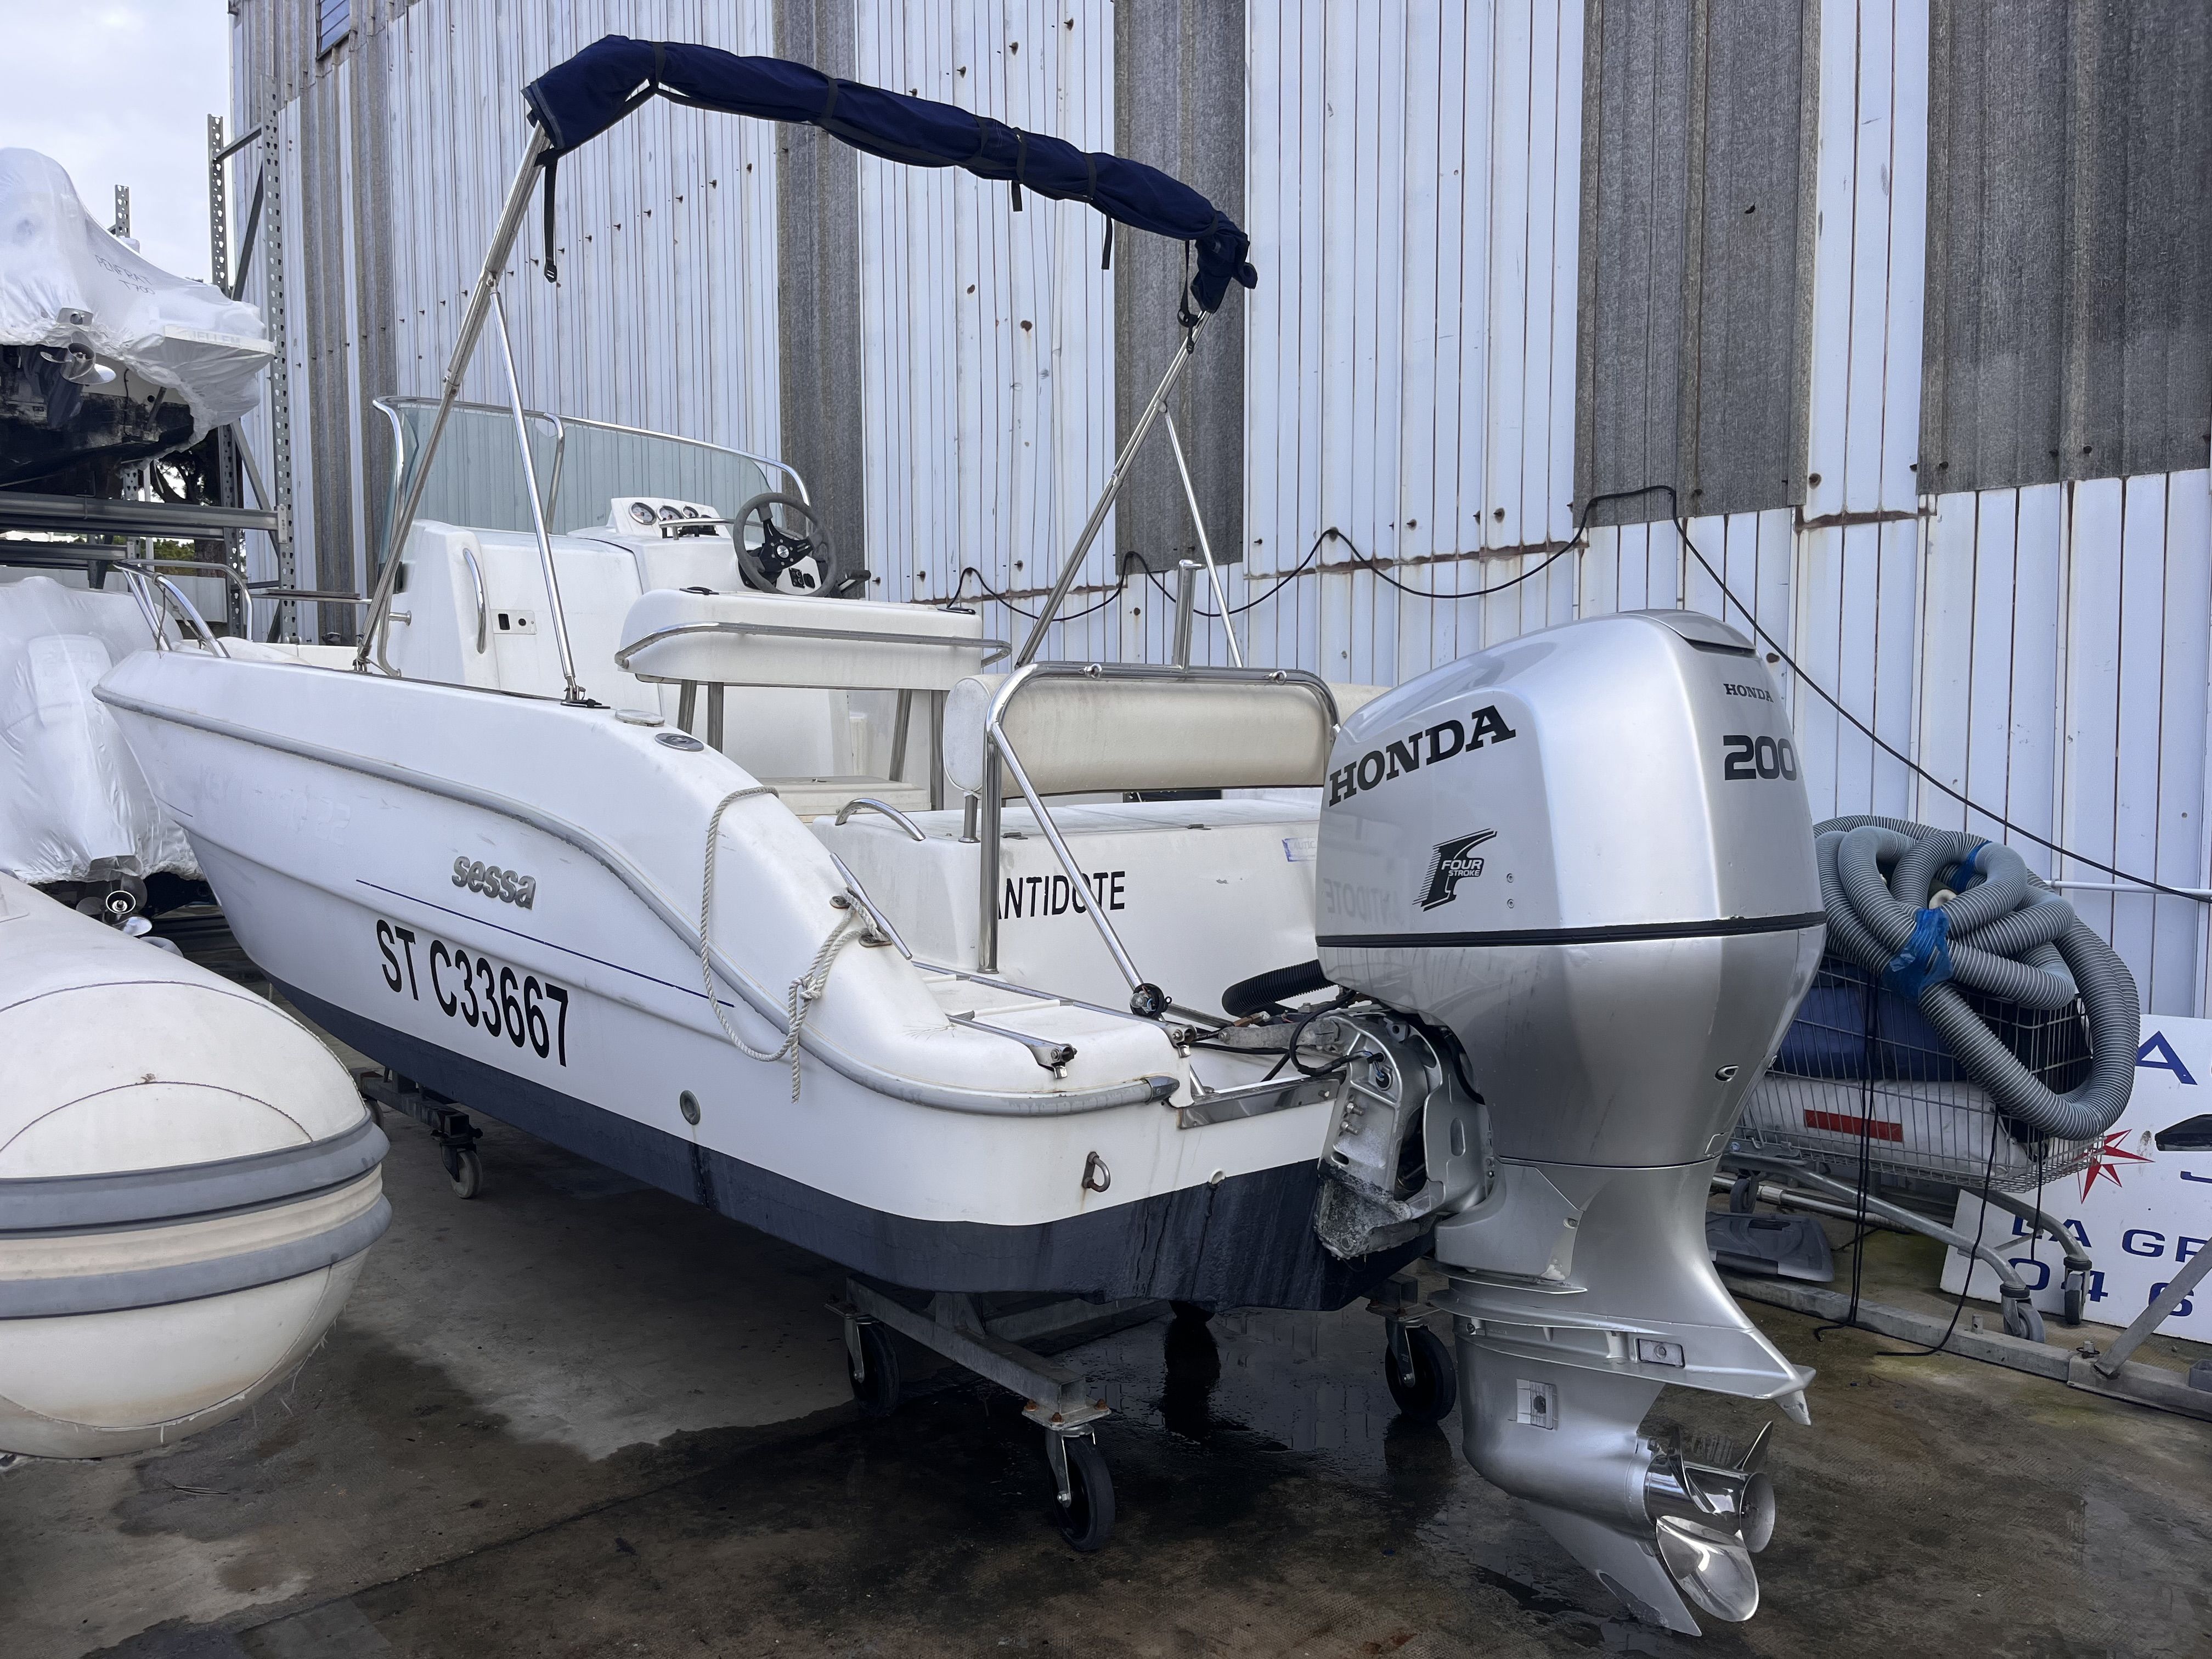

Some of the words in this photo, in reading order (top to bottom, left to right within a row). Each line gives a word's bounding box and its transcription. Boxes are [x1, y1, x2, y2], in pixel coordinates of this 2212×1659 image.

[1723, 684, 1774, 703] HONDA
[1329, 704, 1516, 808] HONDA
[1723, 735, 1797, 781] 200
[452, 856, 536, 910] sessa
[1441, 859, 1482, 871] FOUR
[998, 871, 1125, 920] NTIDOTE
[376, 919, 419, 1001] ST
[430, 940, 568, 1068] C33667
